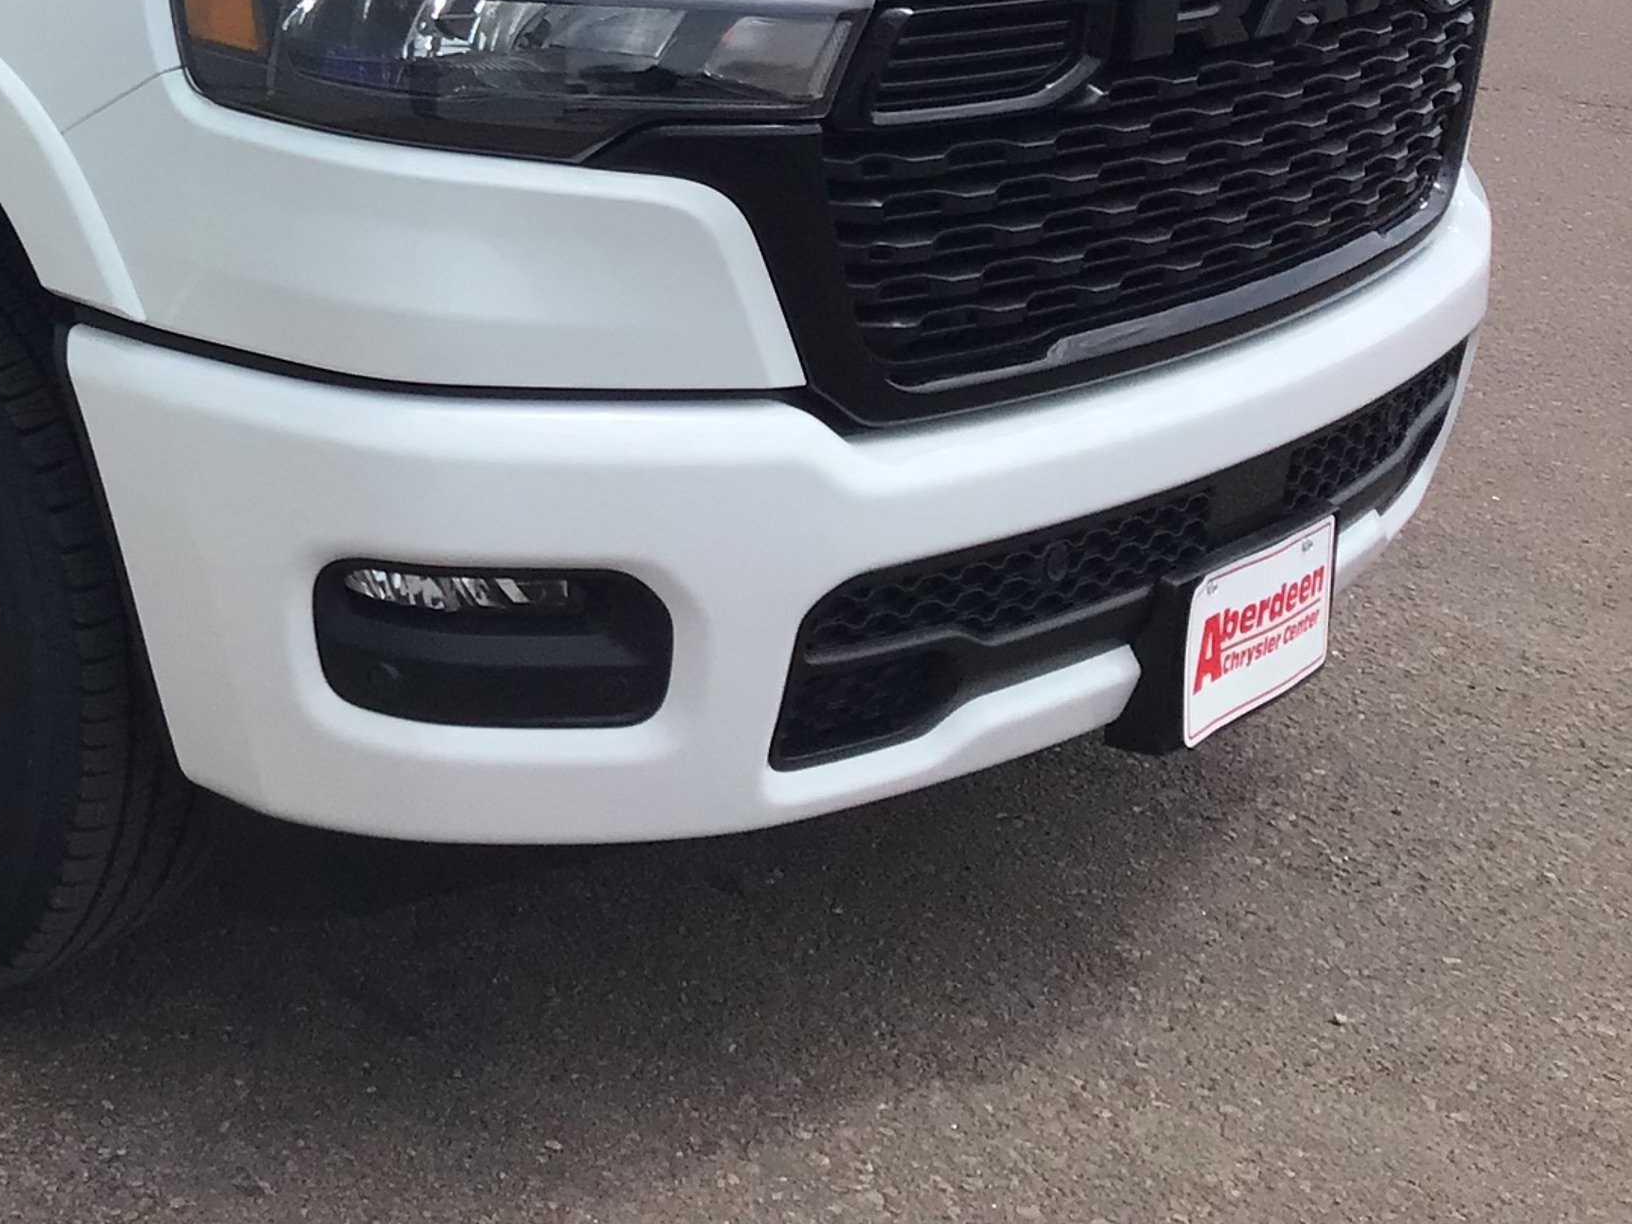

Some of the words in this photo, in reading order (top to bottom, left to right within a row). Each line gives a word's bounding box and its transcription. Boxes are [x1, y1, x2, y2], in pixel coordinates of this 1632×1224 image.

[1192, 565, 1325, 697] Aberdeen
[1222, 633, 1282, 675] Chrysler
[1282, 609, 1320, 645] Center
